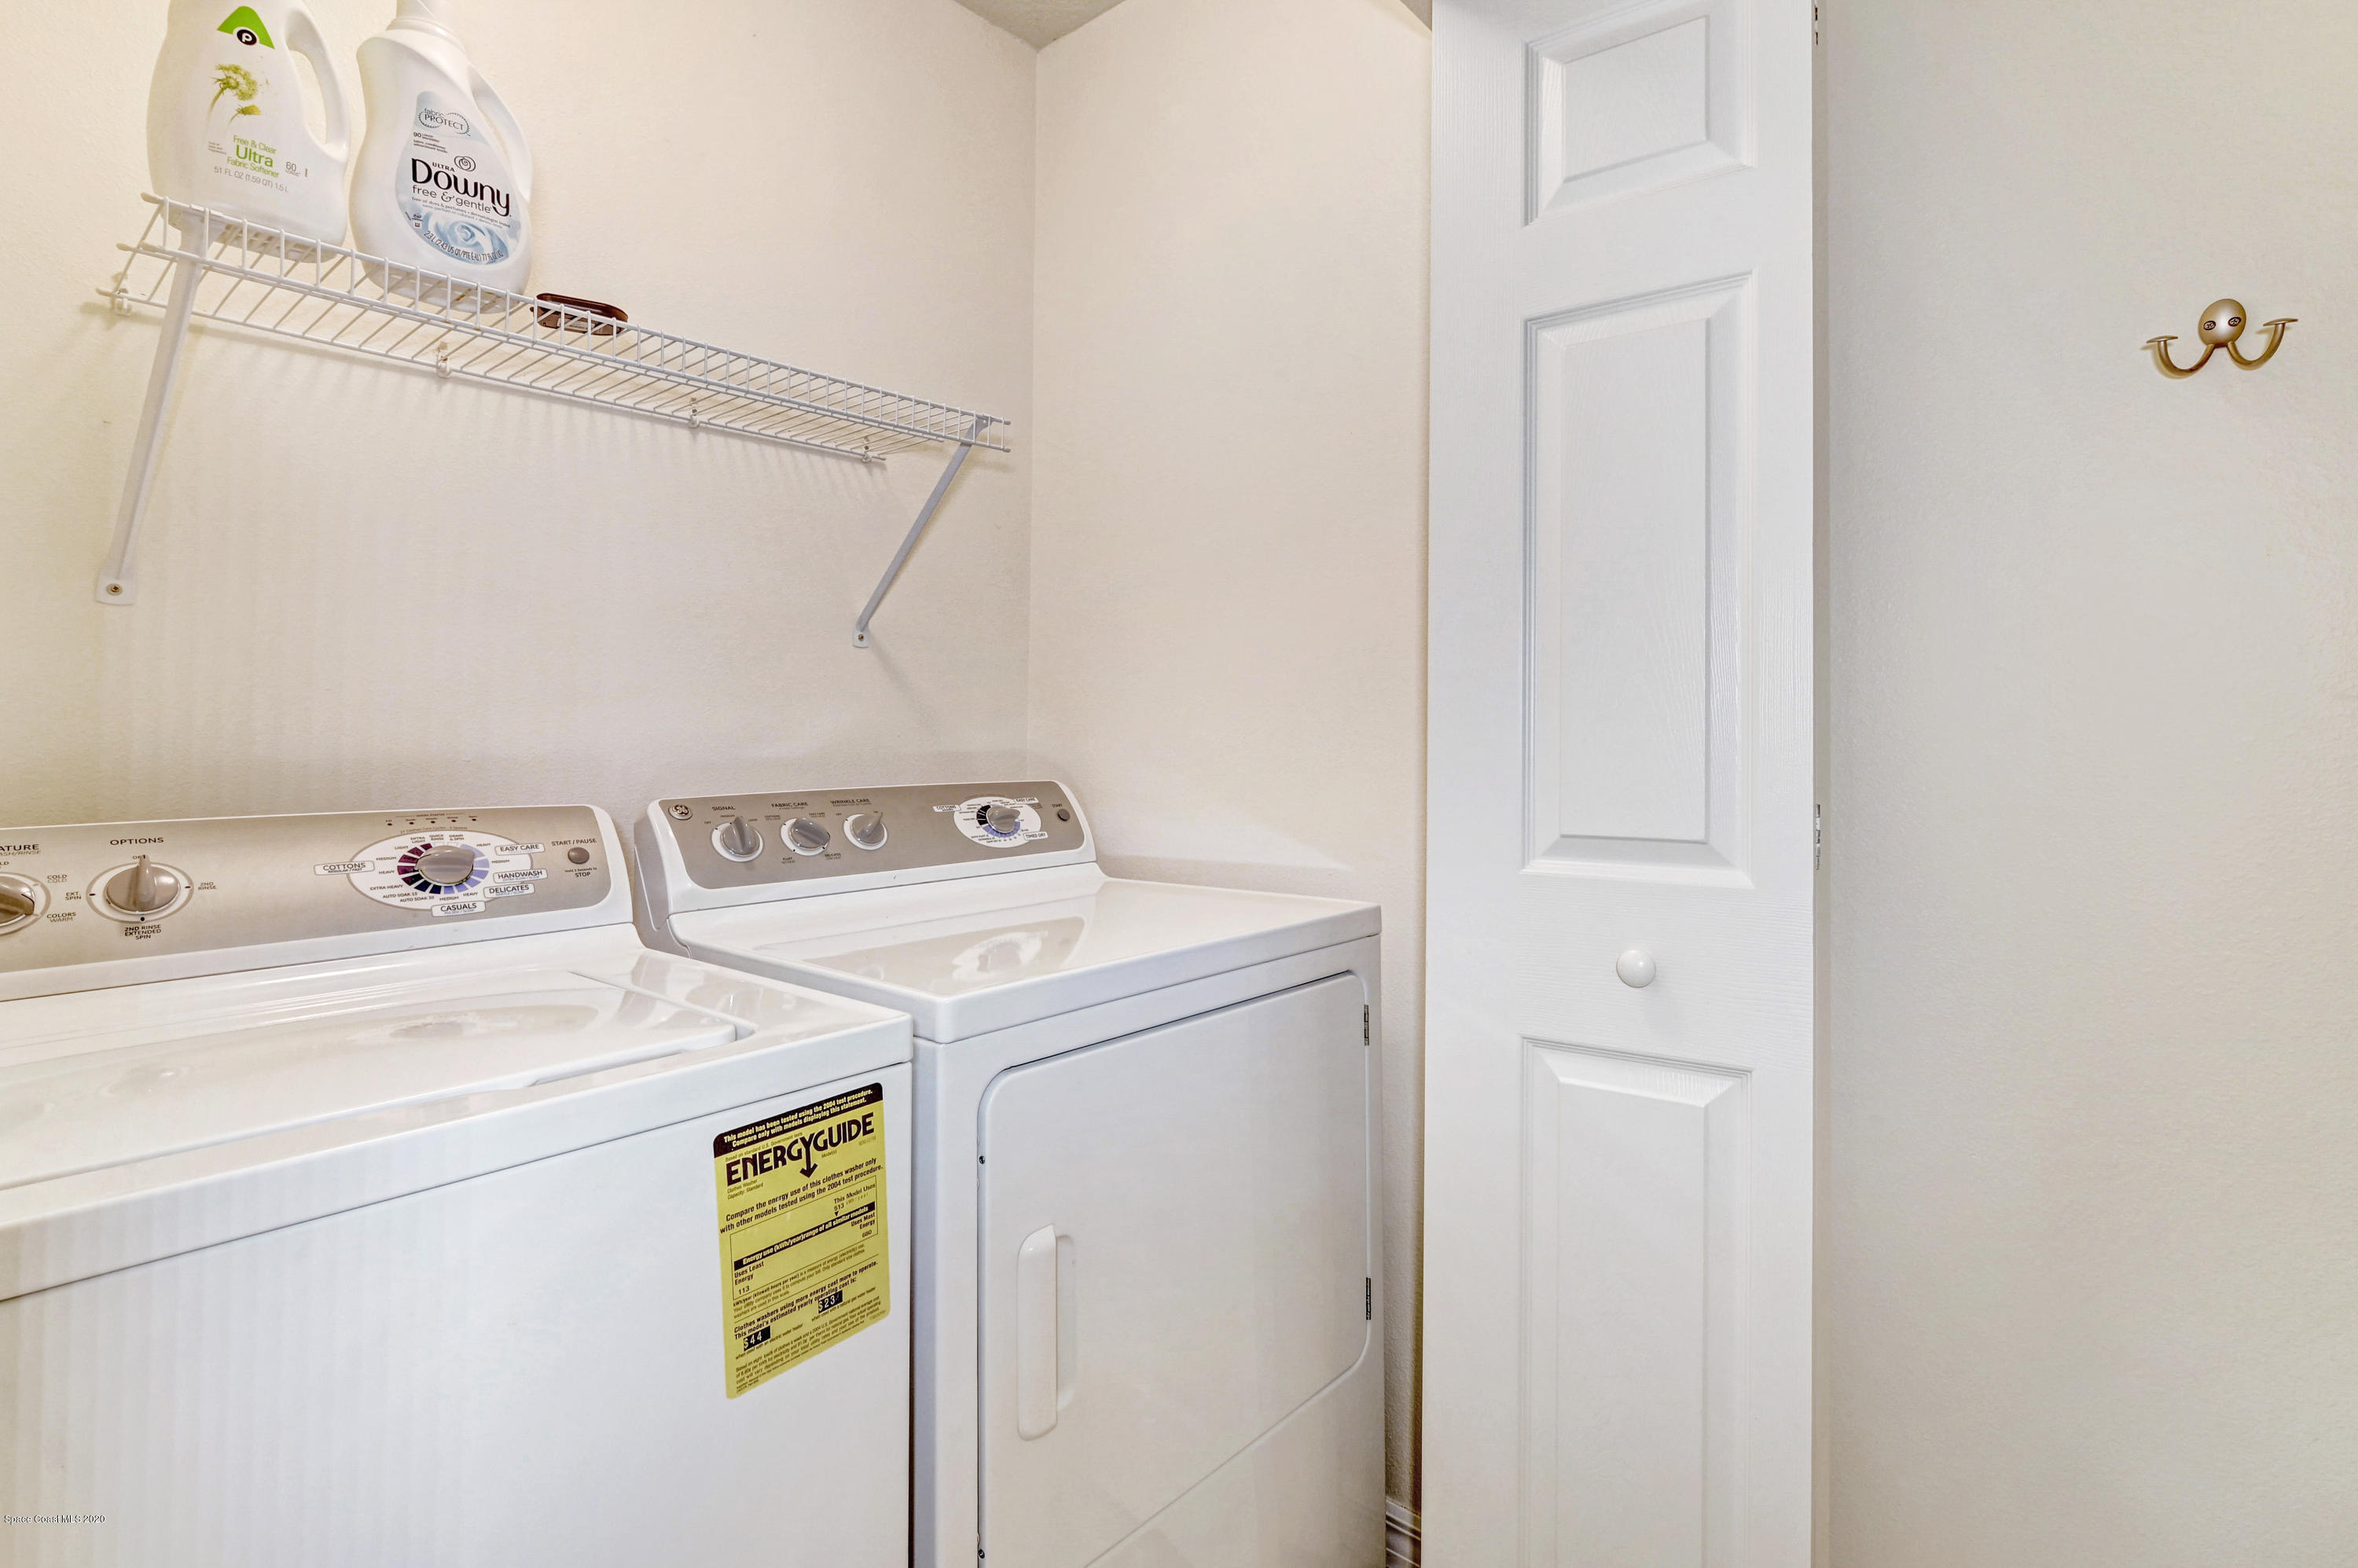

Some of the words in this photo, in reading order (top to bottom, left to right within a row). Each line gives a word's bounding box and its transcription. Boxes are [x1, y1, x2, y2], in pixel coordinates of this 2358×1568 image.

[424, 114, 464, 130] PROTECT
[233, 135, 249, 146] Free
[259, 141, 277, 154] Clear
[236, 145, 274, 167] Ultra
[227, 156, 248, 168] Fabric
[250, 163, 280, 178] Softener
[286, 161, 297, 171] 60
[432, 162, 455, 172] ULTRA
[412, 158, 509, 217] Downy
[413, 185, 437, 198] free
[441, 192, 454, 203] &
[456, 197, 490, 214] gentle
[110, 837, 164, 846] OPTIONS
[498, 870, 542, 879] HANDWASH
[489, 884, 530, 894] DELICATES
[440, 903, 477, 912] CASUALS
[124, 928, 162, 937] EXTENDED
[724, 1134, 736, 1143] This
[737, 1127, 755, 1138] model
[766, 1120, 780, 1129] been
[781, 1113, 798, 1124] tested
[799, 1109, 813, 1118] using
[824, 1100, 835, 1110] 2004
[847, 1089, 872, 1101] procedure.
[733, 1134, 756, 1148] Compare
[758, 1129, 769, 1138] only
[771, 1126, 783, 1134] with
[784, 1119, 803, 1129] models
[803, 1110, 829, 1122] displaying
[830, 1105, 839, 1114] this
[841, 1097, 867, 1110] statement.
[725, 1112, 875, 1187] ENERGYGUIDE
[726, 1206, 755, 1221] Compare
[756, 1202, 766, 1210] the
[768, 1192, 788, 1205] energy
[822, 1171, 843, 1184] clothes
[844, 1163, 864, 1174] washer
[865, 1158, 876, 1166] only
[847, 1188, 862, 1199] Model
[720, 1223, 734, 1234] with
[736, 1217, 753, 1228] other
[755, 1206, 777, 1220] models
[778, 1197, 798, 1210] tested
[799, 1192, 815, 1202] using
[827, 1181, 841, 1191] 2004
[843, 1175, 854, 1184] test
[854, 1165, 883, 1181] procedure.
[834, 1203, 844, 1211] 513
[863, 1212, 875, 1221] Most
[860, 1219, 875, 1229] Energy
[743, 1252, 762, 1265] Energy
[763, 1247, 773, 1256] use
[833, 1214, 850, 1225] similar
[850, 1206, 869, 1218] models
[749, 1261, 764, 1272] Least
[735, 1273, 753, 1285] Energy
[734, 1320, 755, 1333] Clothes
[757, 1309, 778, 1322] washers
[780, 1302, 794, 1312] using
[795, 1294, 808, 1303] more
[810, 1284, 826, 1297] energy
[828, 1279, 838, 1288] cost
[839, 1273, 851, 1282] more
[858, 1261, 878, 1273] operate.
[739, 1286, 750, 1295] 113
[734, 1331, 747, 1339] This
[747, 1320, 769, 1333] model's
[770, 1306, 796, 1322] estimated
[798, 1298, 813, 1311] yearly
[814, 1286, 838, 1301] operating
[839, 1280, 849, 1289] cost
